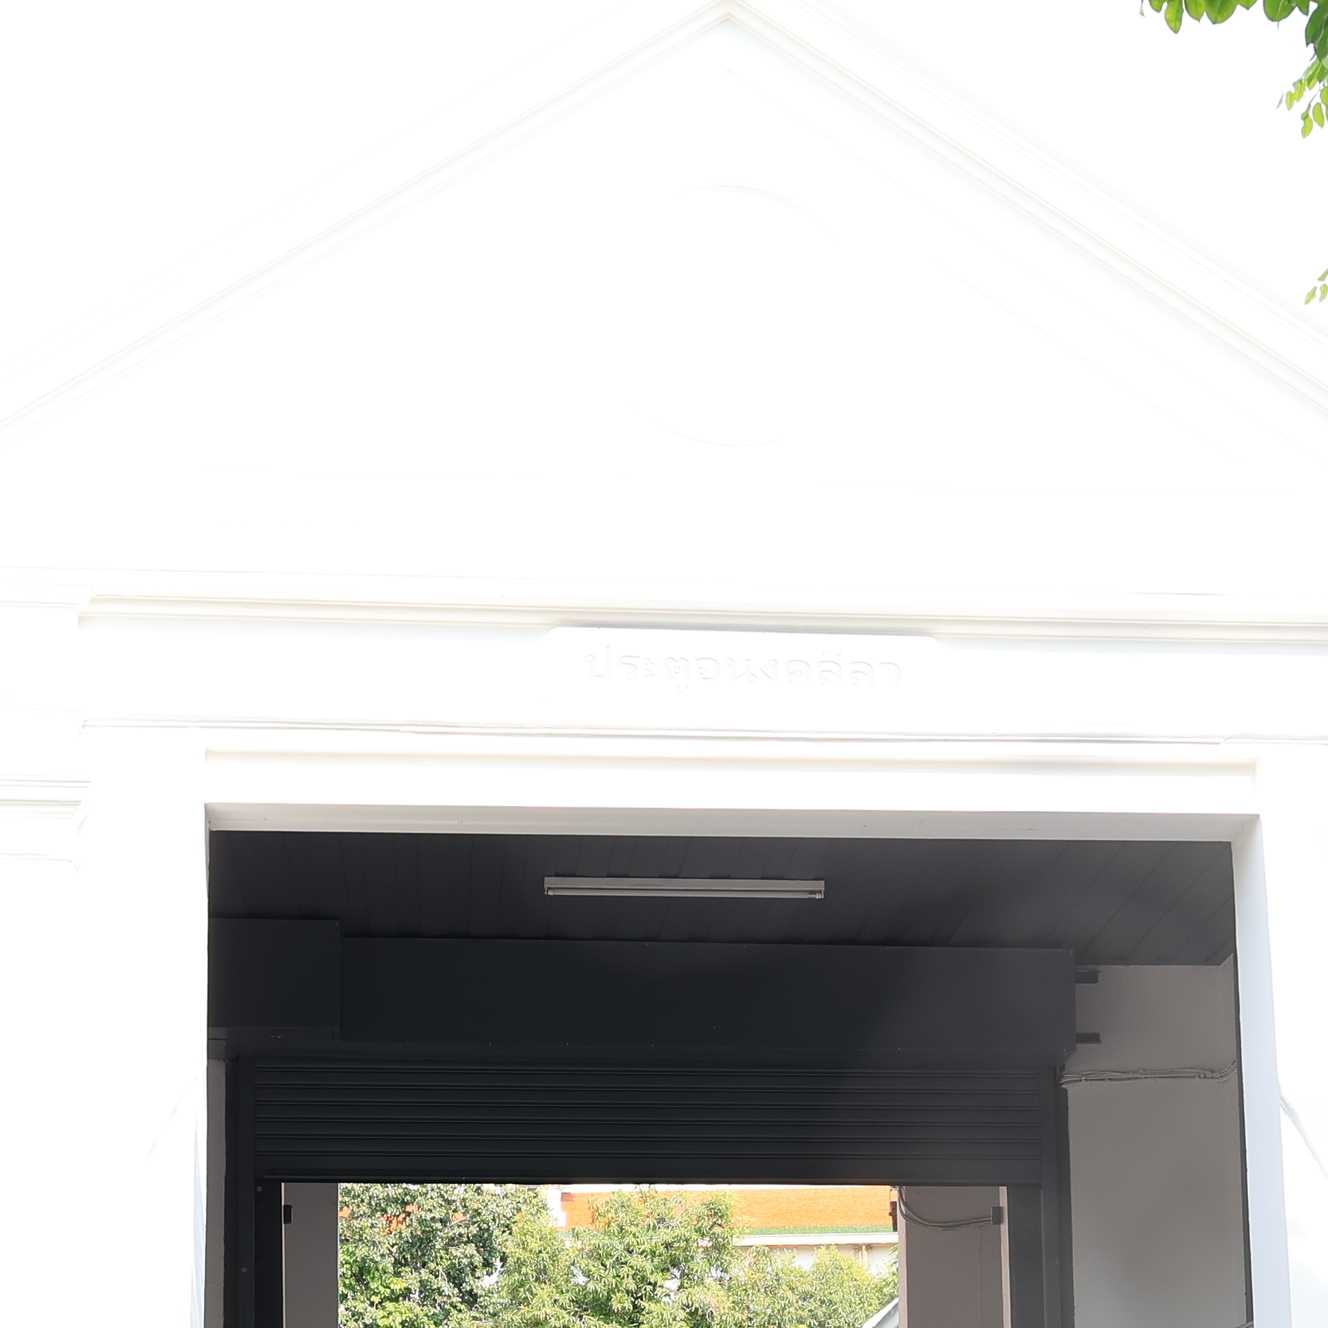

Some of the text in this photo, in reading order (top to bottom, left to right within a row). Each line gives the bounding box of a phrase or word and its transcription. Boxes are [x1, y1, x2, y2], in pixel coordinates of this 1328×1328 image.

[585, 645, 902, 692] ประตูอนงคลีลา
